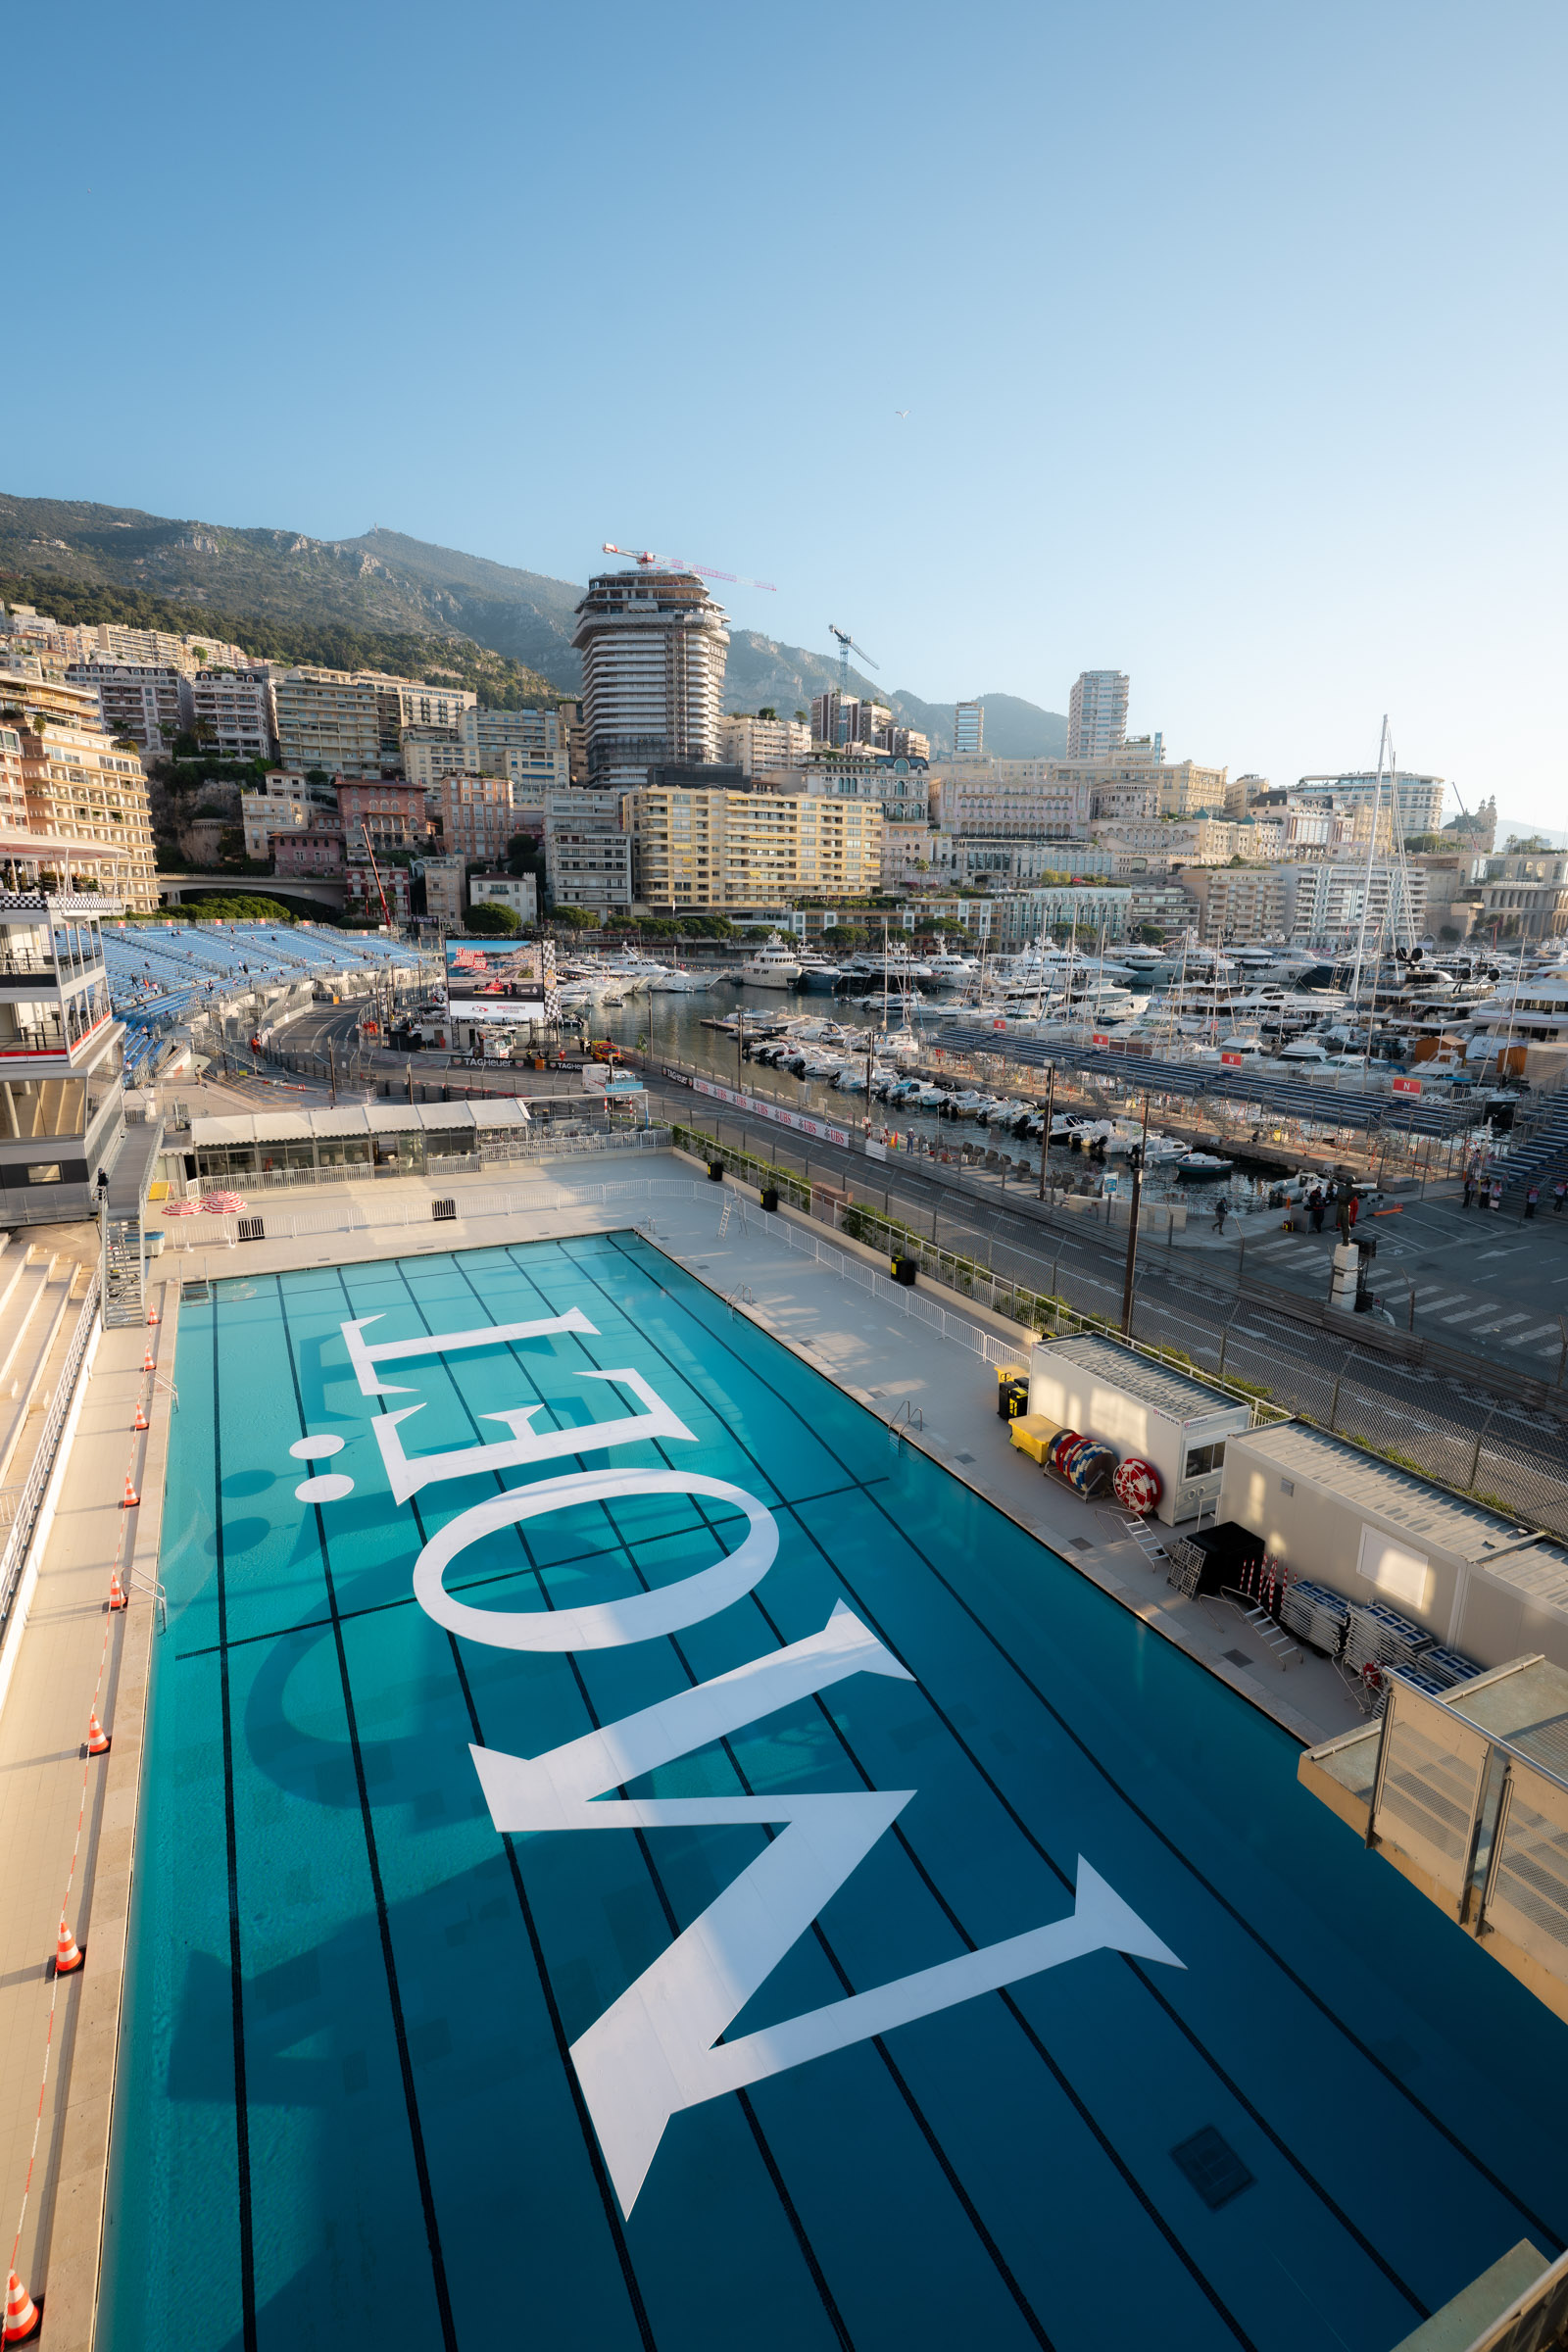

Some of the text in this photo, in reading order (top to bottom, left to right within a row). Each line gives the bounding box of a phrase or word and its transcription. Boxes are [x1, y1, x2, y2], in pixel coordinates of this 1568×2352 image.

[716, 1088, 727, 1100] UBS
[736, 1096, 747, 1107] UBS
[757, 1104, 768, 1115] UBS
[779, 1113, 792, 1124] UBS
[804, 1120, 816, 1134] UBS
[830, 1130, 844, 1144] UBS
[289, 1306, 1189, 2222] MOËT
